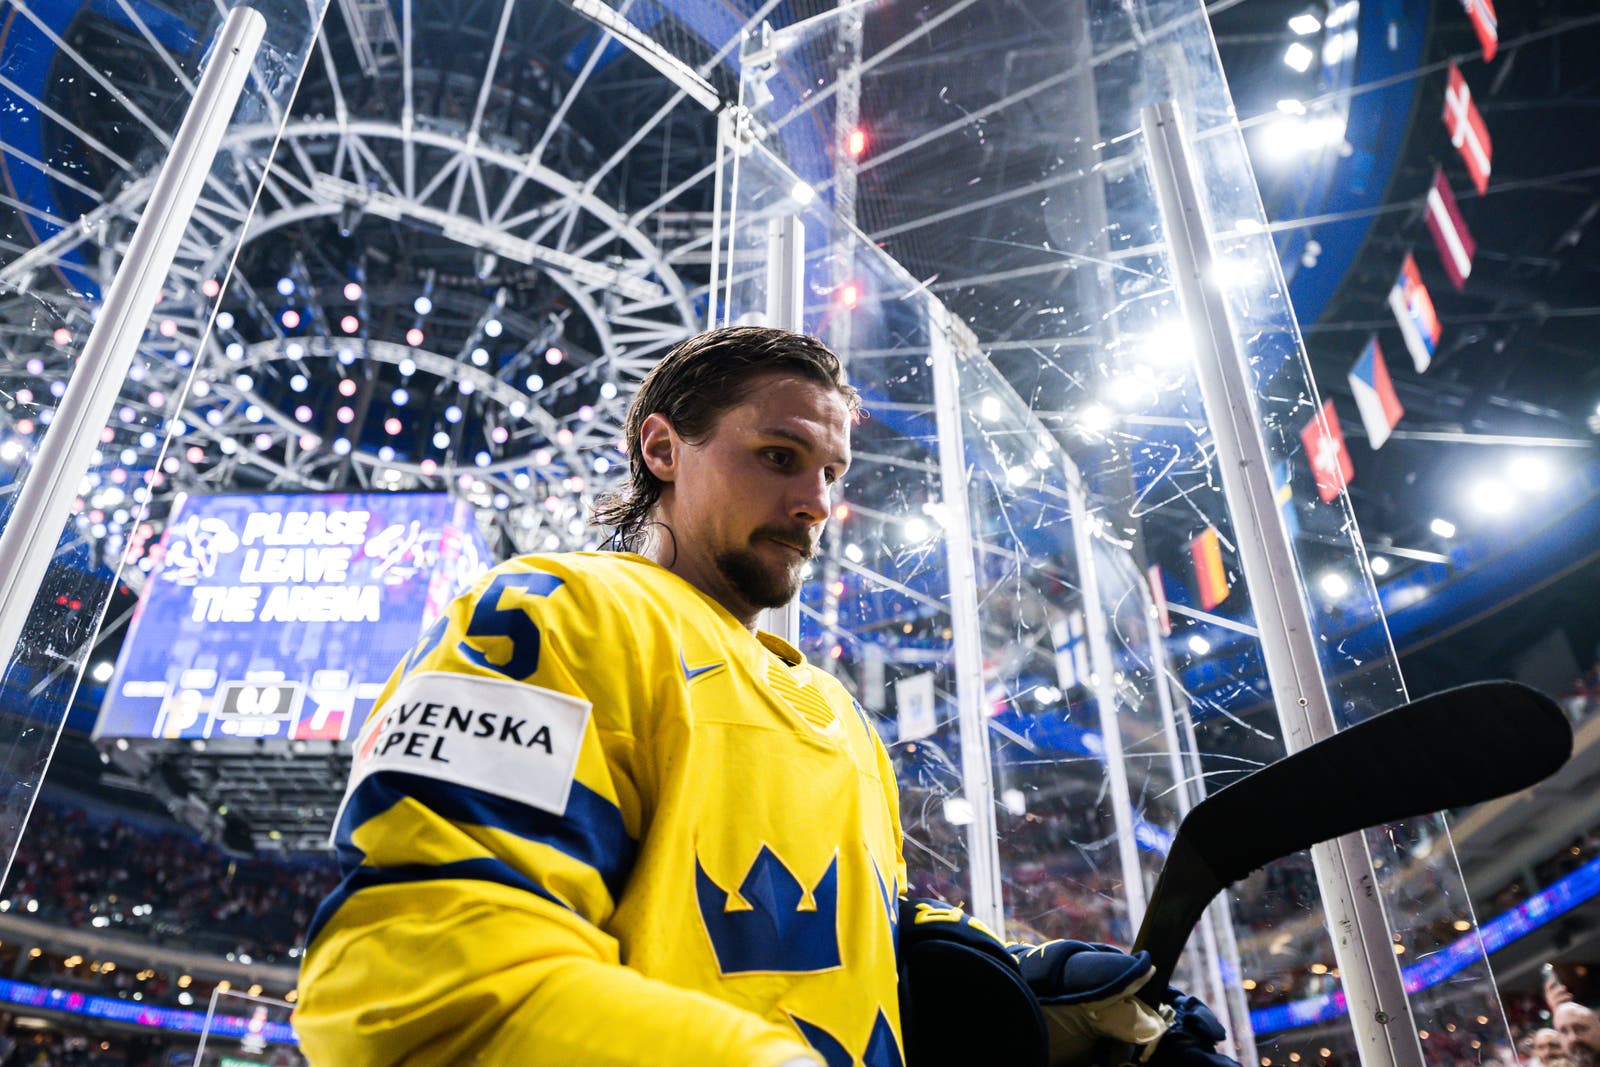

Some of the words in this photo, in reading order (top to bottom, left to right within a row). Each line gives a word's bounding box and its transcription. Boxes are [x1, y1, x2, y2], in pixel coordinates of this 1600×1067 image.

[242, 511, 370, 545] PLEASE
[240, 548, 353, 582] LEAVE
[192, 586, 261, 622] THE
[259, 585, 380, 622] ARENA
[370, 732, 450, 763] PEL
